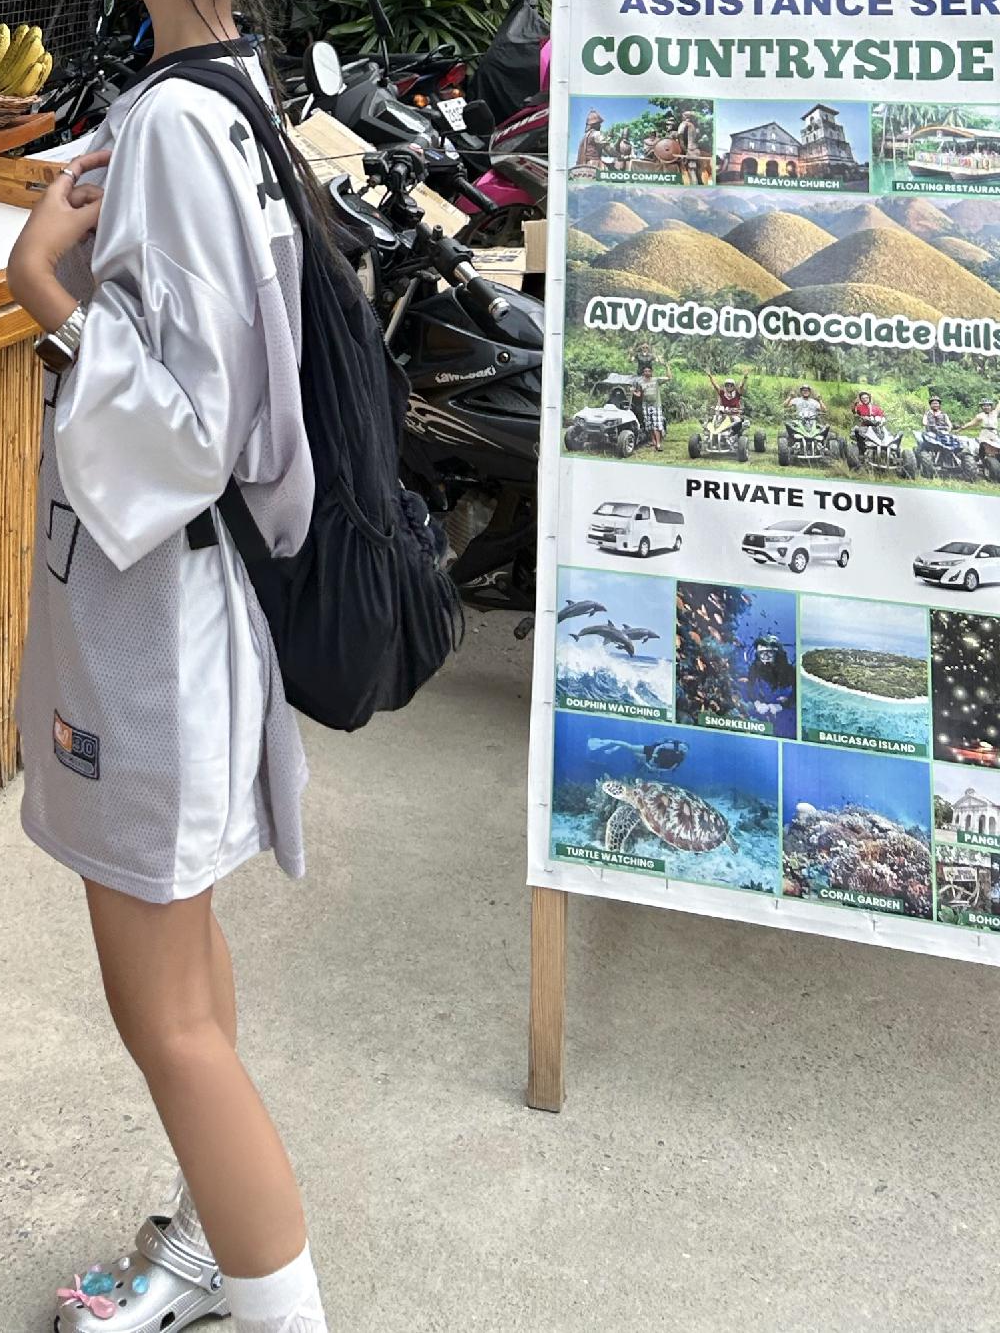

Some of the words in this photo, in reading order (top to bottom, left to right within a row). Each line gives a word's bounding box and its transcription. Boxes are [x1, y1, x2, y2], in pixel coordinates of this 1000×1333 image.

[581, 35, 994, 82] COUNTRYSIDE
[601, 172, 631, 181] BLOOD
[631, 173, 677, 182] COMPACT
[747, 176, 799, 187] BACLAYON
[799, 179, 840, 189] CHURCH
[896, 182, 944, 191] FLOATING
[589, 300, 642, 327] ATV
[652, 306, 713, 331] ride
[724, 311, 752, 334] in
[763, 310, 932, 346] Chocolate
[685, 478, 804, 508] PRIVATE
[813, 490, 897, 517] TOUR
[566, 698, 608, 712] DOLPHIN
[607, 703, 661, 717] WATCHING
[705, 716, 766, 732] SNORKELING
[819, 731, 878, 749] BALICASAG
[878, 739, 916, 753] ISLAND
[566, 846, 600, 860] TURTLE
[601, 852, 655, 868] WATCHING
[820, 889, 857, 904] CORAL
[857, 894, 901, 909] GARDEN
